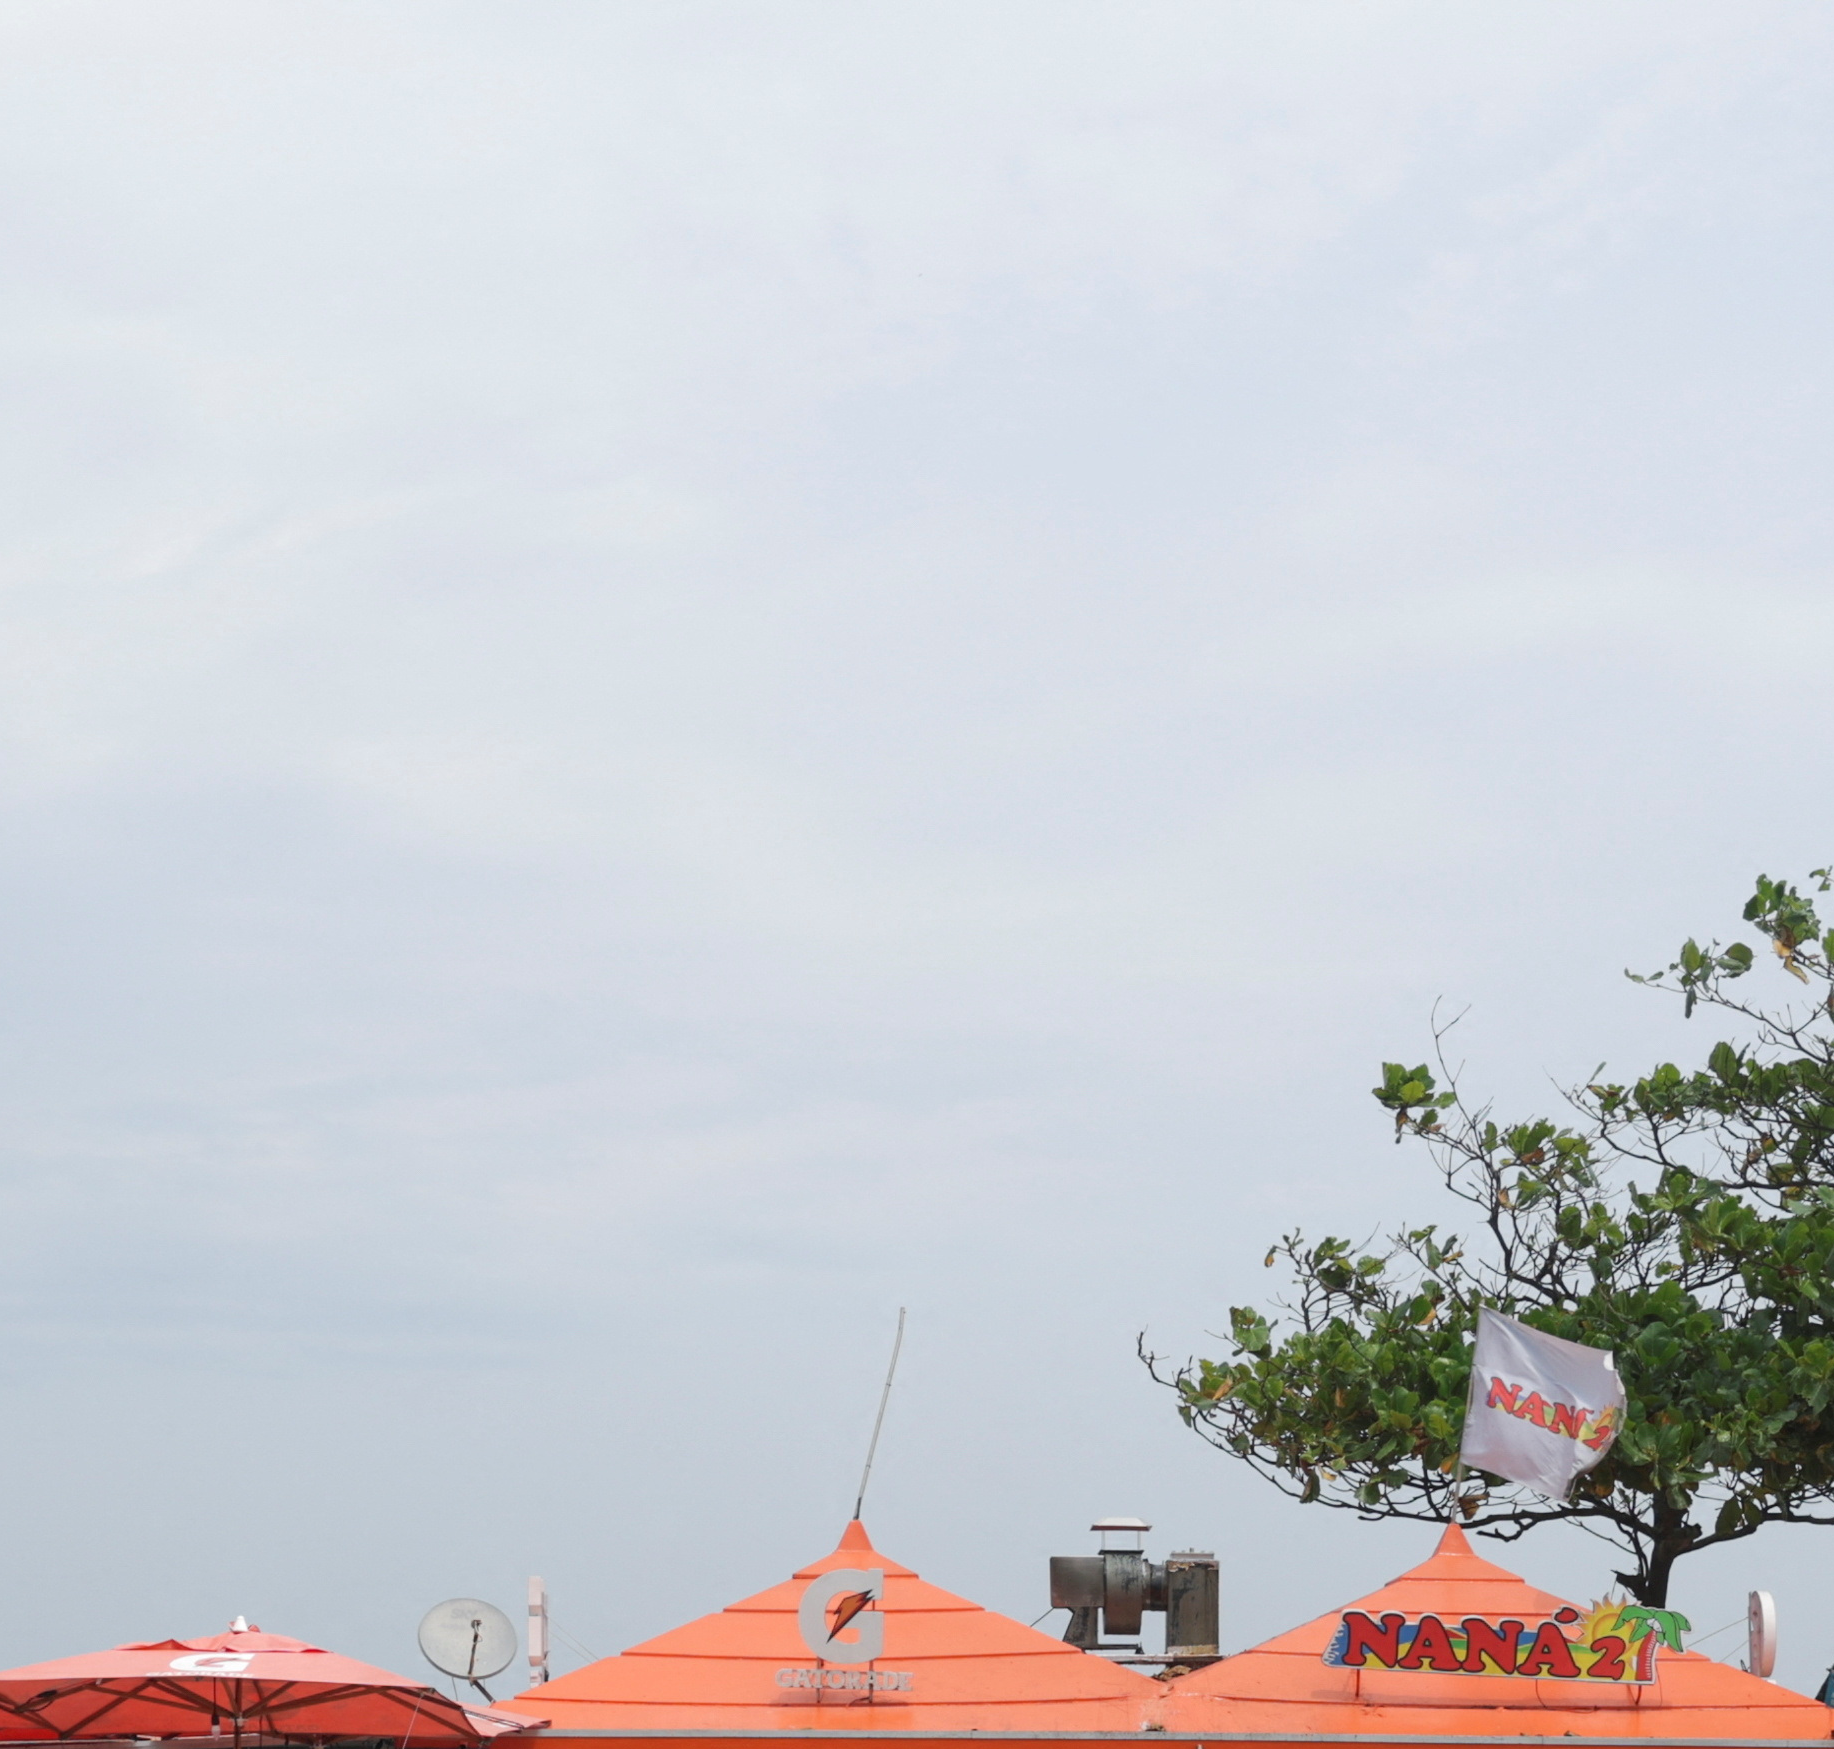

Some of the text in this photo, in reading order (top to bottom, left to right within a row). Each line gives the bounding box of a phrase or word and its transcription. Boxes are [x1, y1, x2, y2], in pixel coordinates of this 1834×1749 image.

[798, 1568, 885, 1664] G
[1341, 1606, 1627, 1681] NANÁ 2
[775, 1668, 914, 1691] GATORADE
